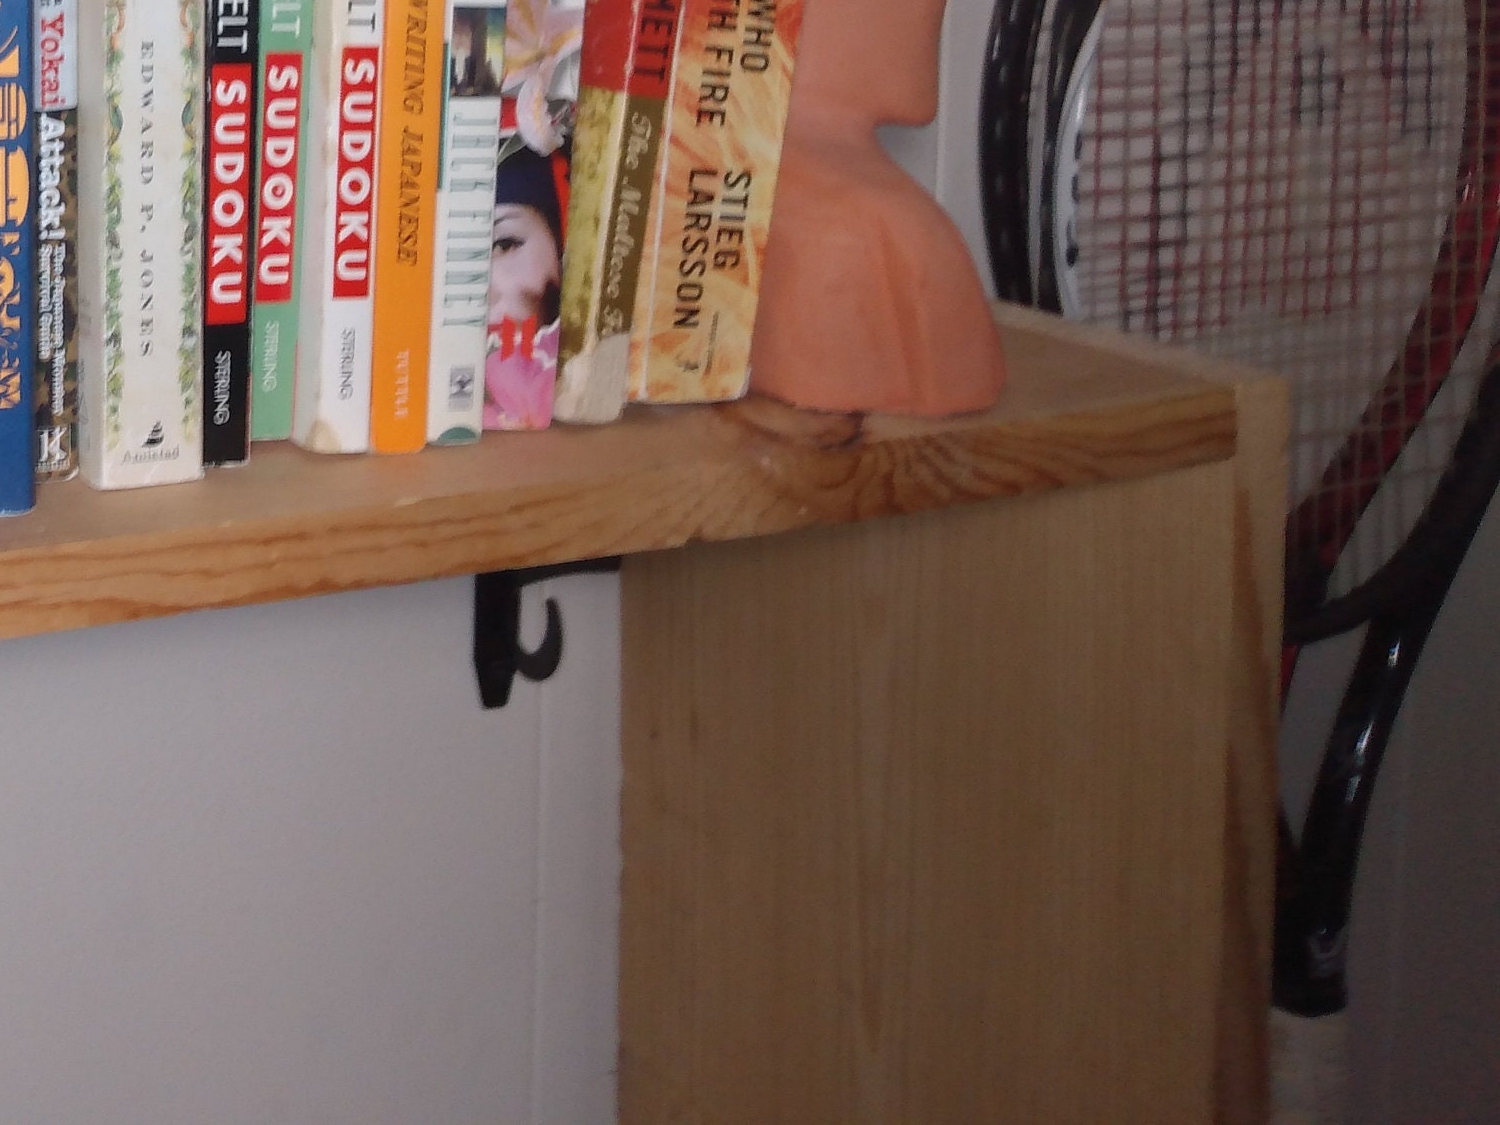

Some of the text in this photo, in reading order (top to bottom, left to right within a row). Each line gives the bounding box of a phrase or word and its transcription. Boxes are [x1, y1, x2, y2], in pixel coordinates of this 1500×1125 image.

[37, 12, 66, 241] Yokai Attack!
[626, 111, 652, 171] The
[696, 42, 735, 128] FIRE
[139, 40, 156, 358] EDWARD P. JONES
[210, 77, 247, 305] SUDOKU
[258, 64, 299, 287] SUDOKU
[336, 57, 376, 281] SUDOKU
[396, 125, 425, 267] JAPANESE
[442, 112, 498, 328] JACK FINNEY
[713, 168, 752, 270] STIEG
[673, 167, 718, 330] LARSSON
[213, 349, 233, 426] STERLING
[262, 321, 280, 393] STERLING
[338, 327, 356, 401] STERLING
